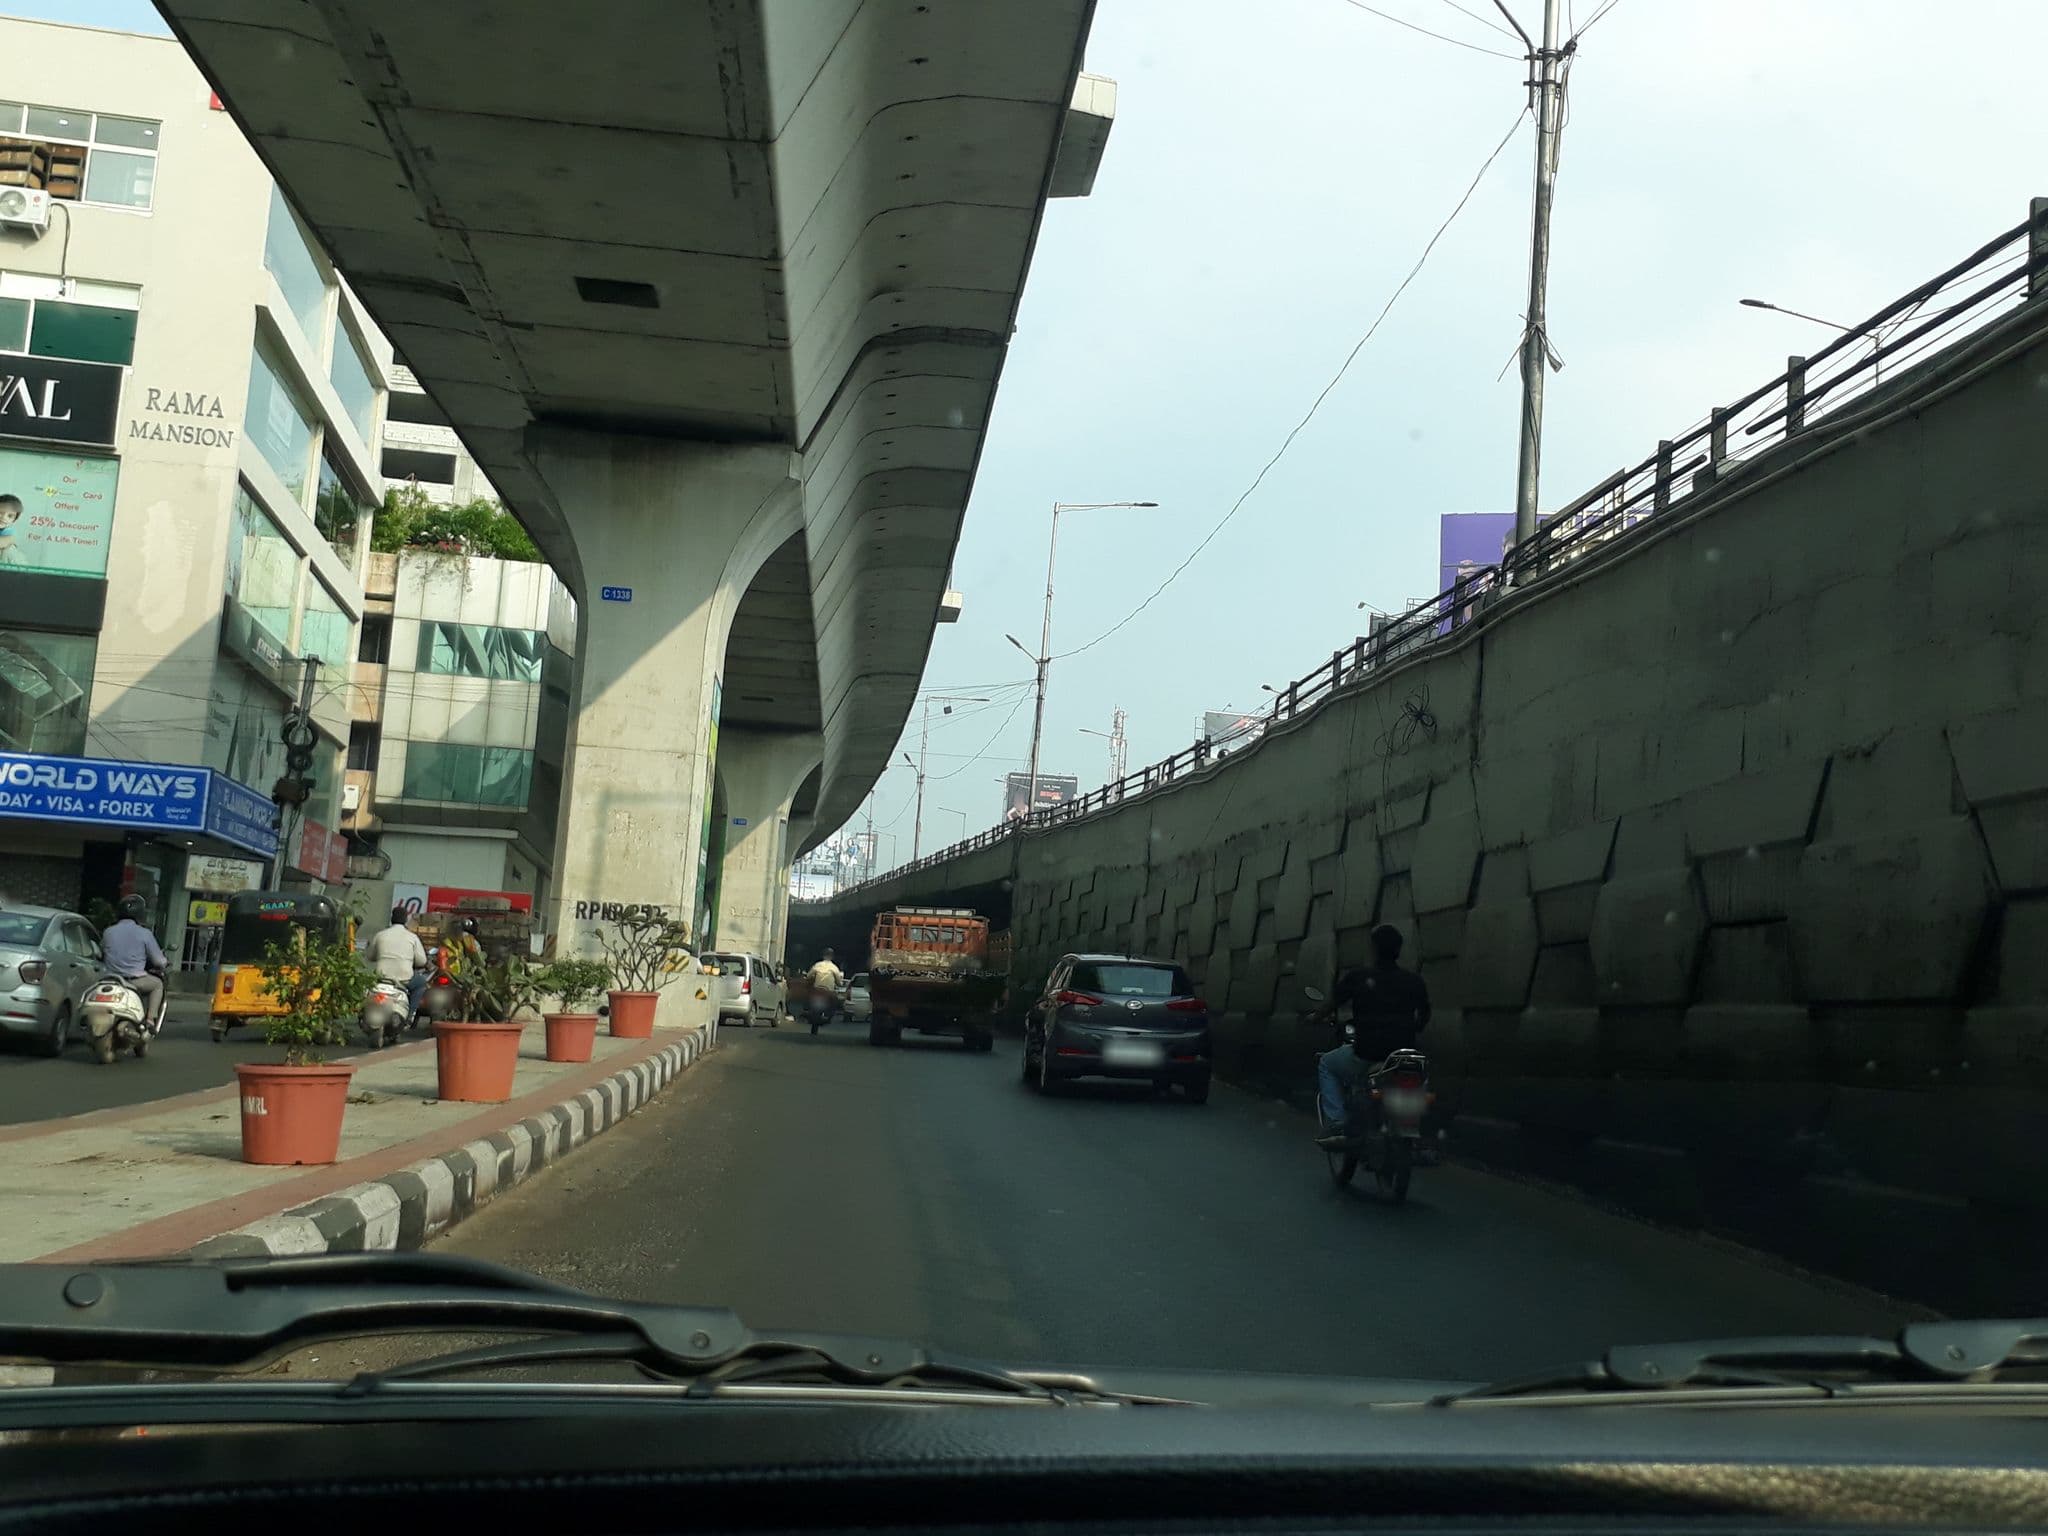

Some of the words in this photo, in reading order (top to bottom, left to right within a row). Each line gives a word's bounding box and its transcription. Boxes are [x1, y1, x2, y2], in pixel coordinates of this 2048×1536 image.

[145, 388, 224, 418] RAMA
[129, 420, 234, 448] MANSION
[31, 516, 55, 528] 25%
[107, 771, 197, 799] WAYS
[47, 795, 84, 813] VISA
[99, 800, 155, 818] FOREX
